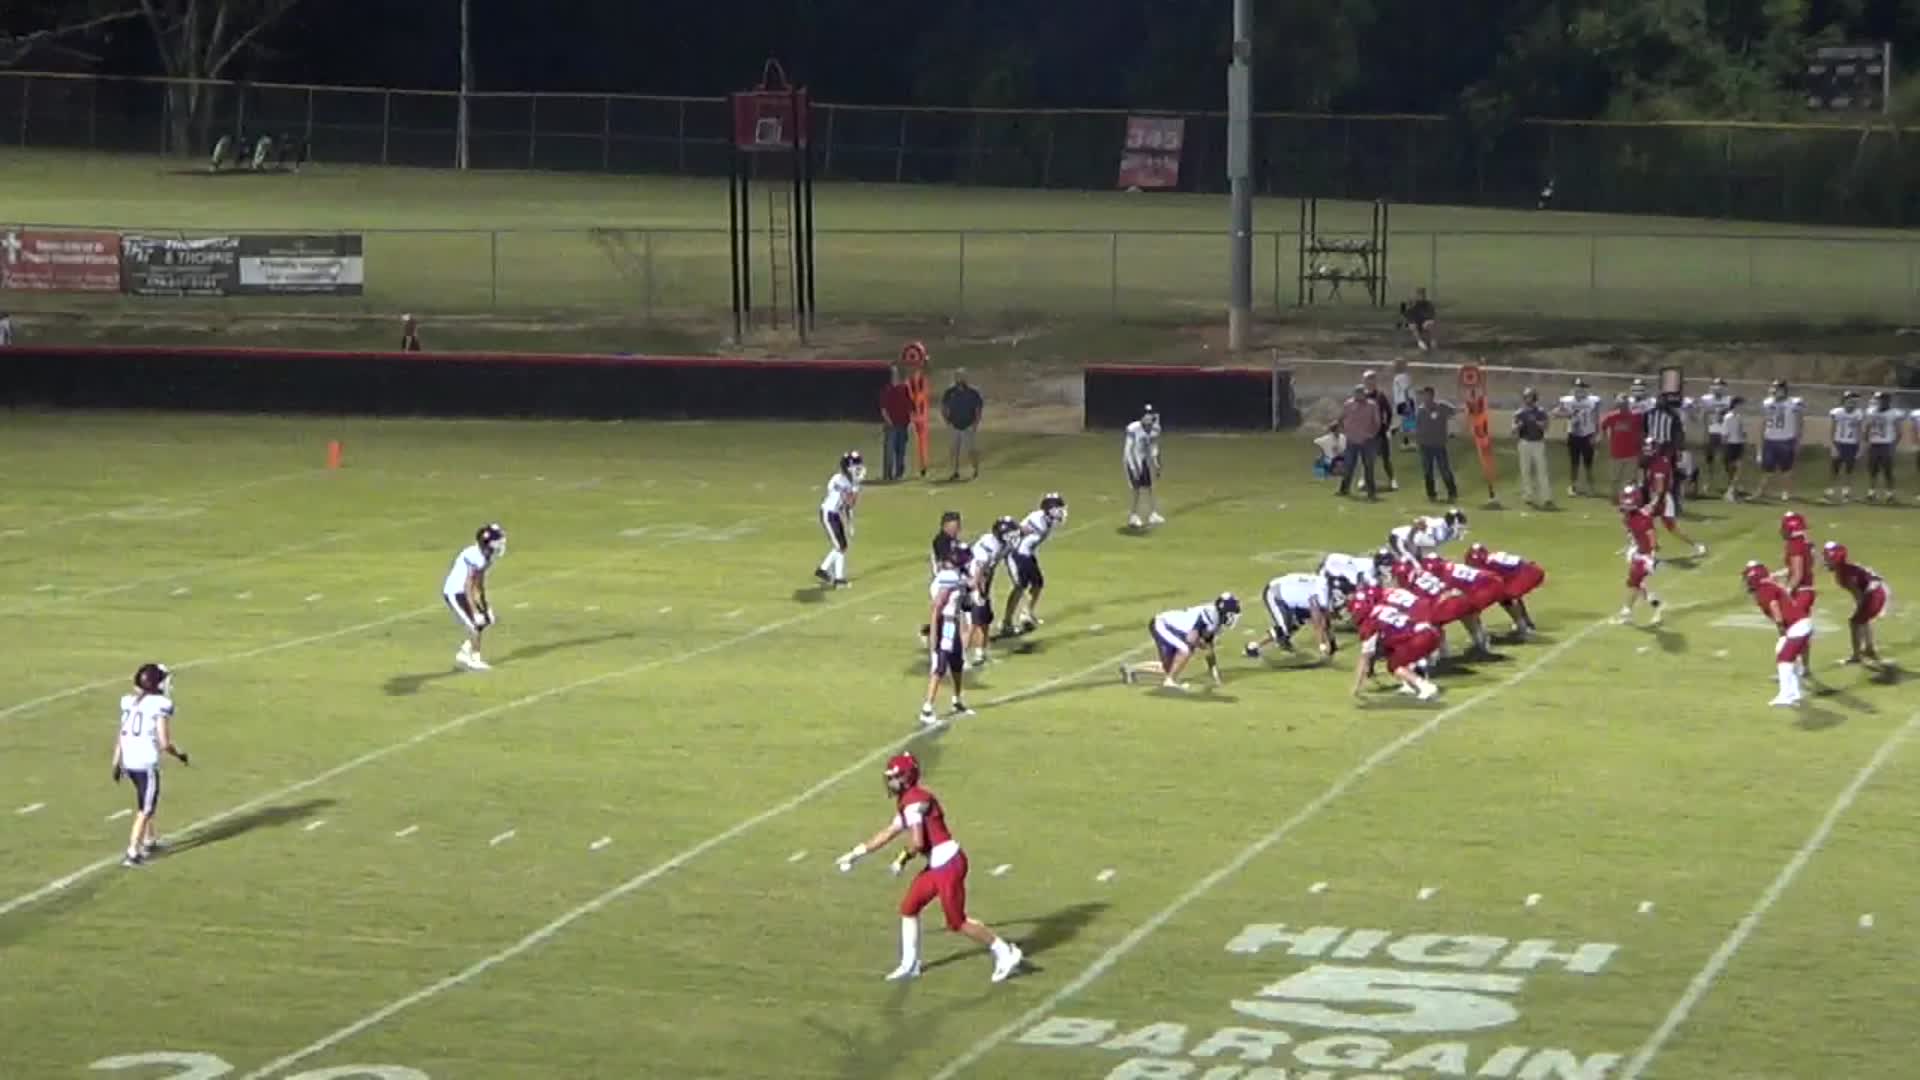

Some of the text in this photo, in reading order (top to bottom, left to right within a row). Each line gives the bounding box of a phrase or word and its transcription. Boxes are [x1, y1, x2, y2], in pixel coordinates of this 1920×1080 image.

[1224, 923, 1620, 974] HIGH
[1230, 965, 1525, 1032] 5
[1017, 1016, 1626, 1080] BARGAIN
